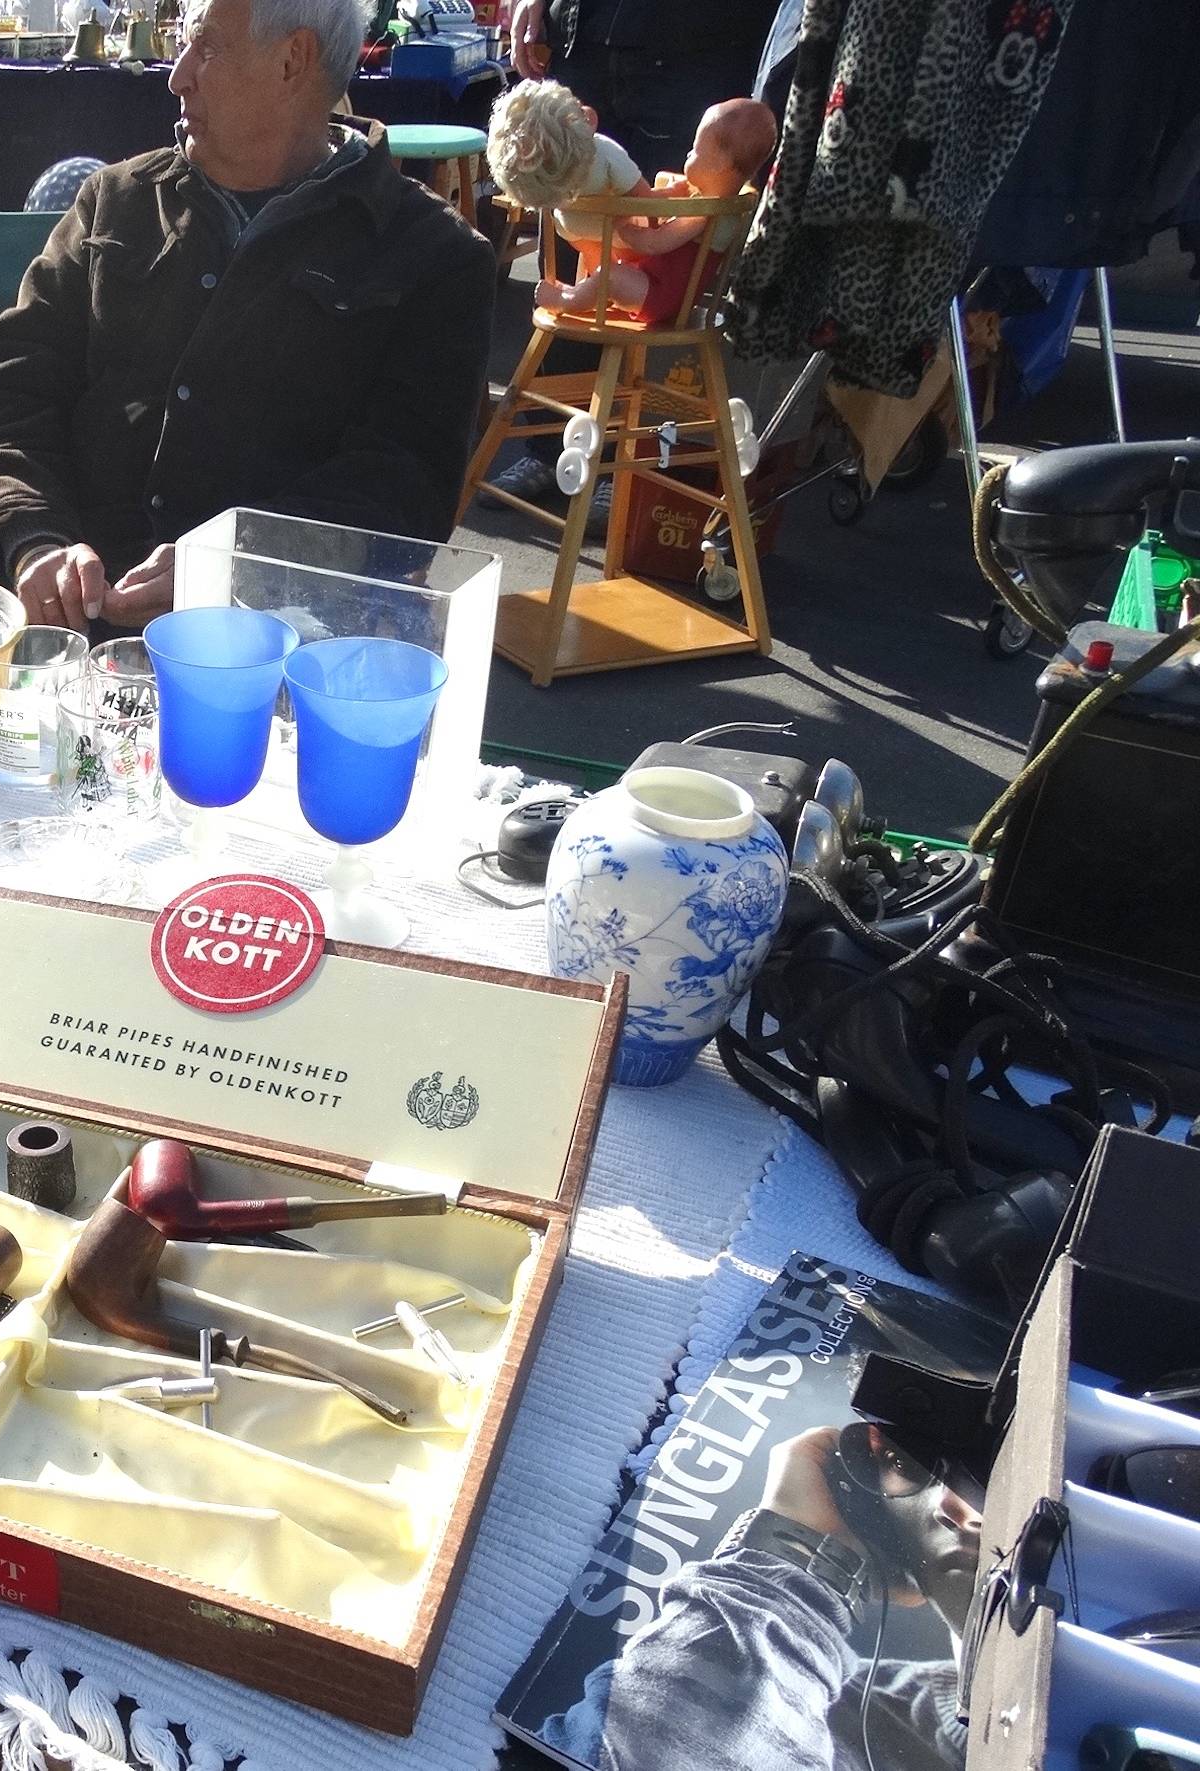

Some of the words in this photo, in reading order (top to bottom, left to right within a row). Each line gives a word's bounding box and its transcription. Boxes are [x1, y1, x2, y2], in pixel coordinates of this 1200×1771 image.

[651, 504, 698, 529] Carlsberg
[657, 526, 692, 549] ØL
[180, 904, 304, 945] OLDEN
[182, 935, 282, 973] KOTT
[39, 1034, 167, 1072] GUARANTED
[174, 1063, 201, 1079] BY
[208, 1070, 343, 1109] OLDENKOTT
[49, 1012, 109, 1036] BRIAR
[117, 1026, 174, 1049] PIPES
[181, 1039, 350, 1085] HANDFINISHED
[809, 1281, 872, 1366] COLLECTION
[570, 1254, 858, 1636] SUNGLASSES
